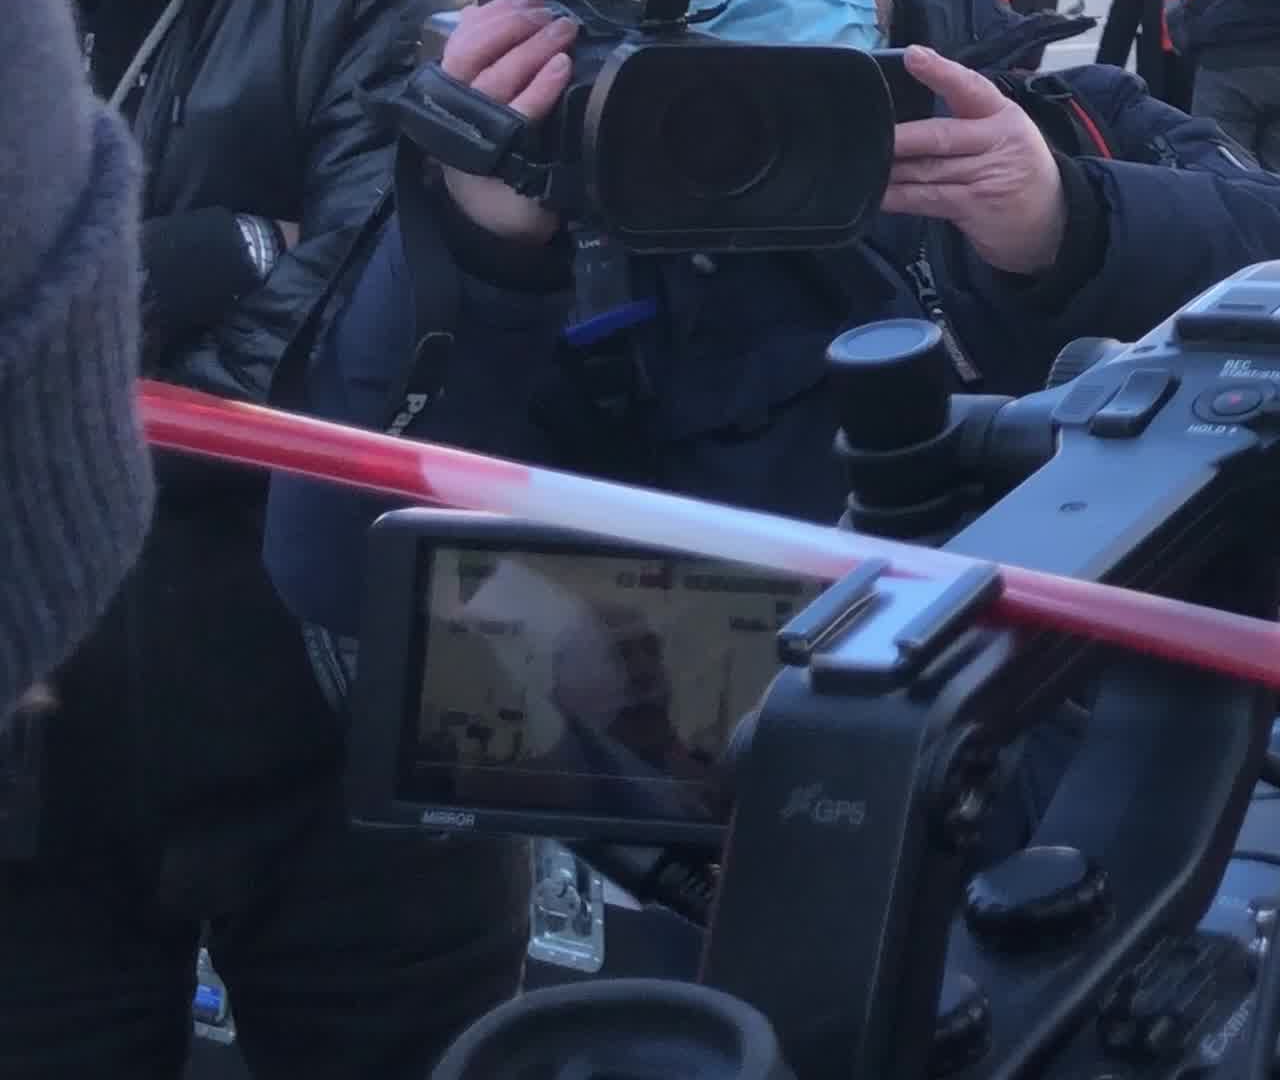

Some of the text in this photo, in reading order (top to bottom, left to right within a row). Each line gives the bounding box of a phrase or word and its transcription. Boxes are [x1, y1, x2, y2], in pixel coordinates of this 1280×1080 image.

[1187, 424, 1226, 433] HOLD
[421, 809, 475, 826] MIRROR
[815, 800, 865, 826] GPS
